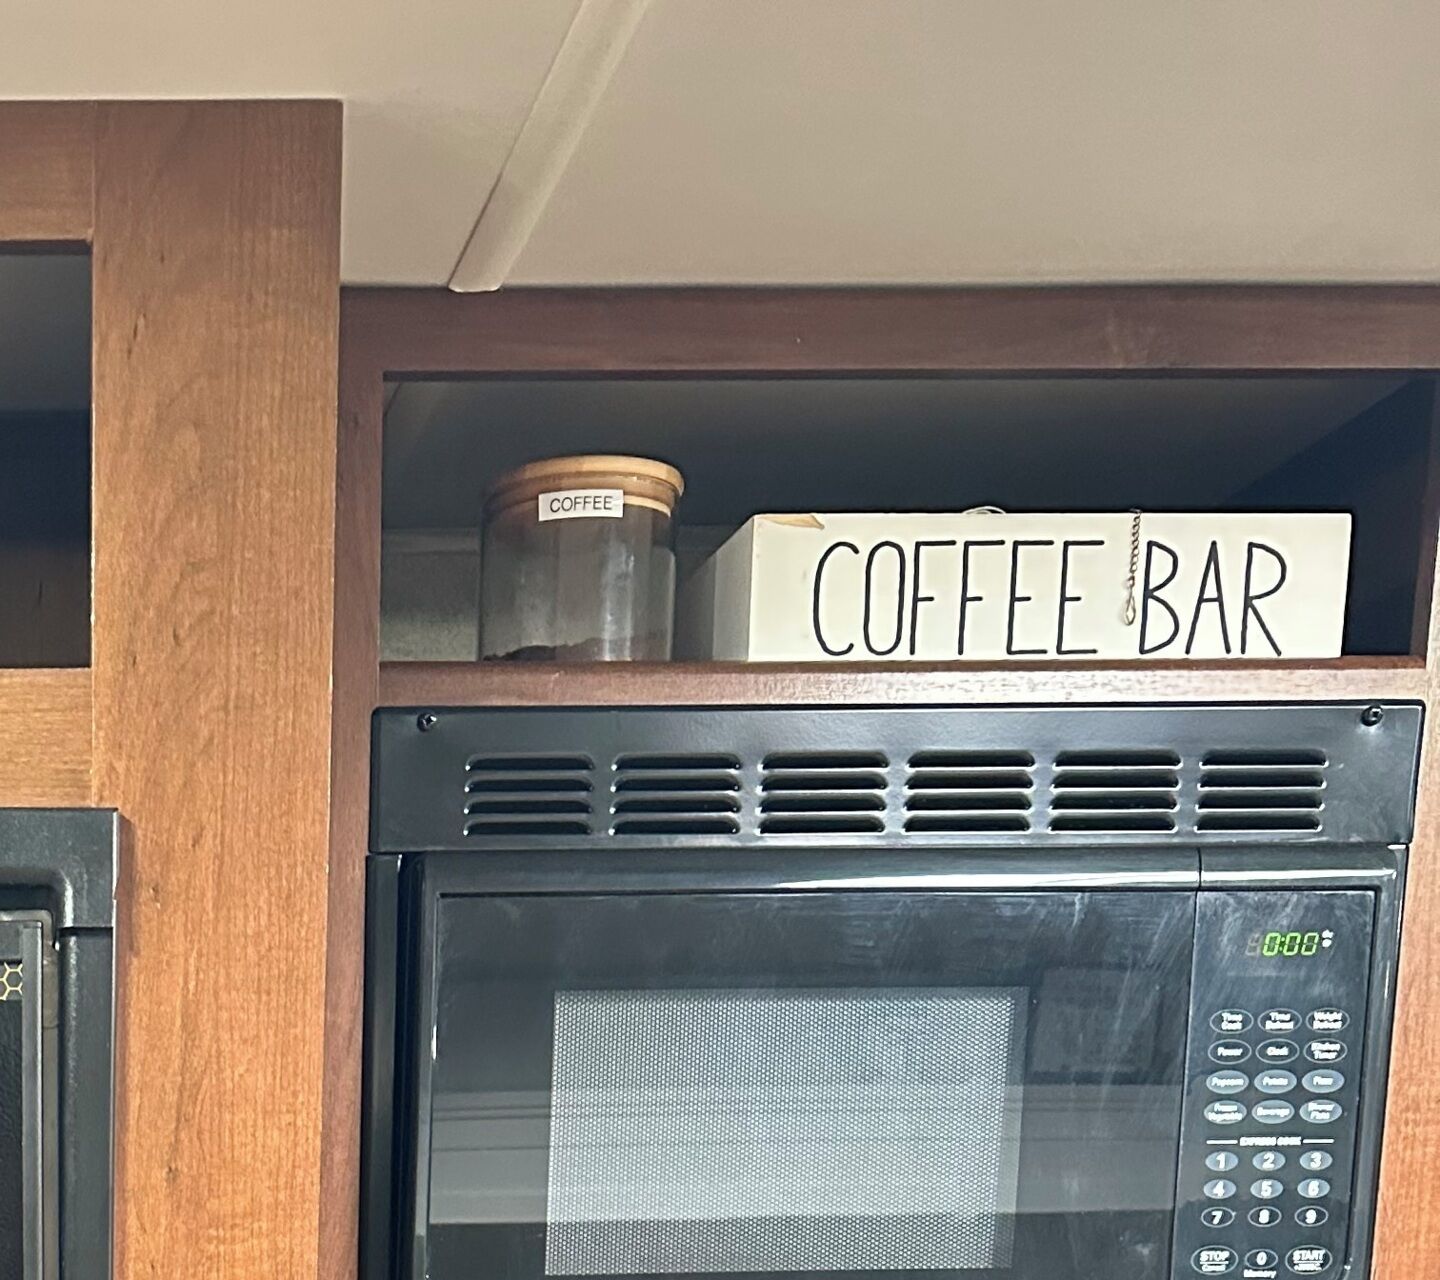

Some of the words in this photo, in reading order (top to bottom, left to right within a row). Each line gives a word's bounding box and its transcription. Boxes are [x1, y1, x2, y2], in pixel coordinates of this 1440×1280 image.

[550, 496, 613, 512] COFFEE
[813, 540, 1105, 656] COFFEE
[1139, 540, 1287, 656] BAR
[1262, 932, 1320, 956] 0:00
[1216, 1152, 1226, 1169] 1
[1262, 1152, 1275, 1169] 2
[1310, 1151, 1322, 1169] 3
[1213, 1180, 1225, 1197] 4
[1261, 1181, 1272, 1197] 5
[1307, 1180, 1320, 1197] 6
[1211, 1210, 1223, 1225] 7
[1259, 1209, 1270, 1224] 8
[1305, 1209, 1317, 1224] 9
[1199, 1250, 1230, 1262] STOP
[1256, 1251, 1268, 1266] 0
[1292, 1250, 1326, 1262] START
